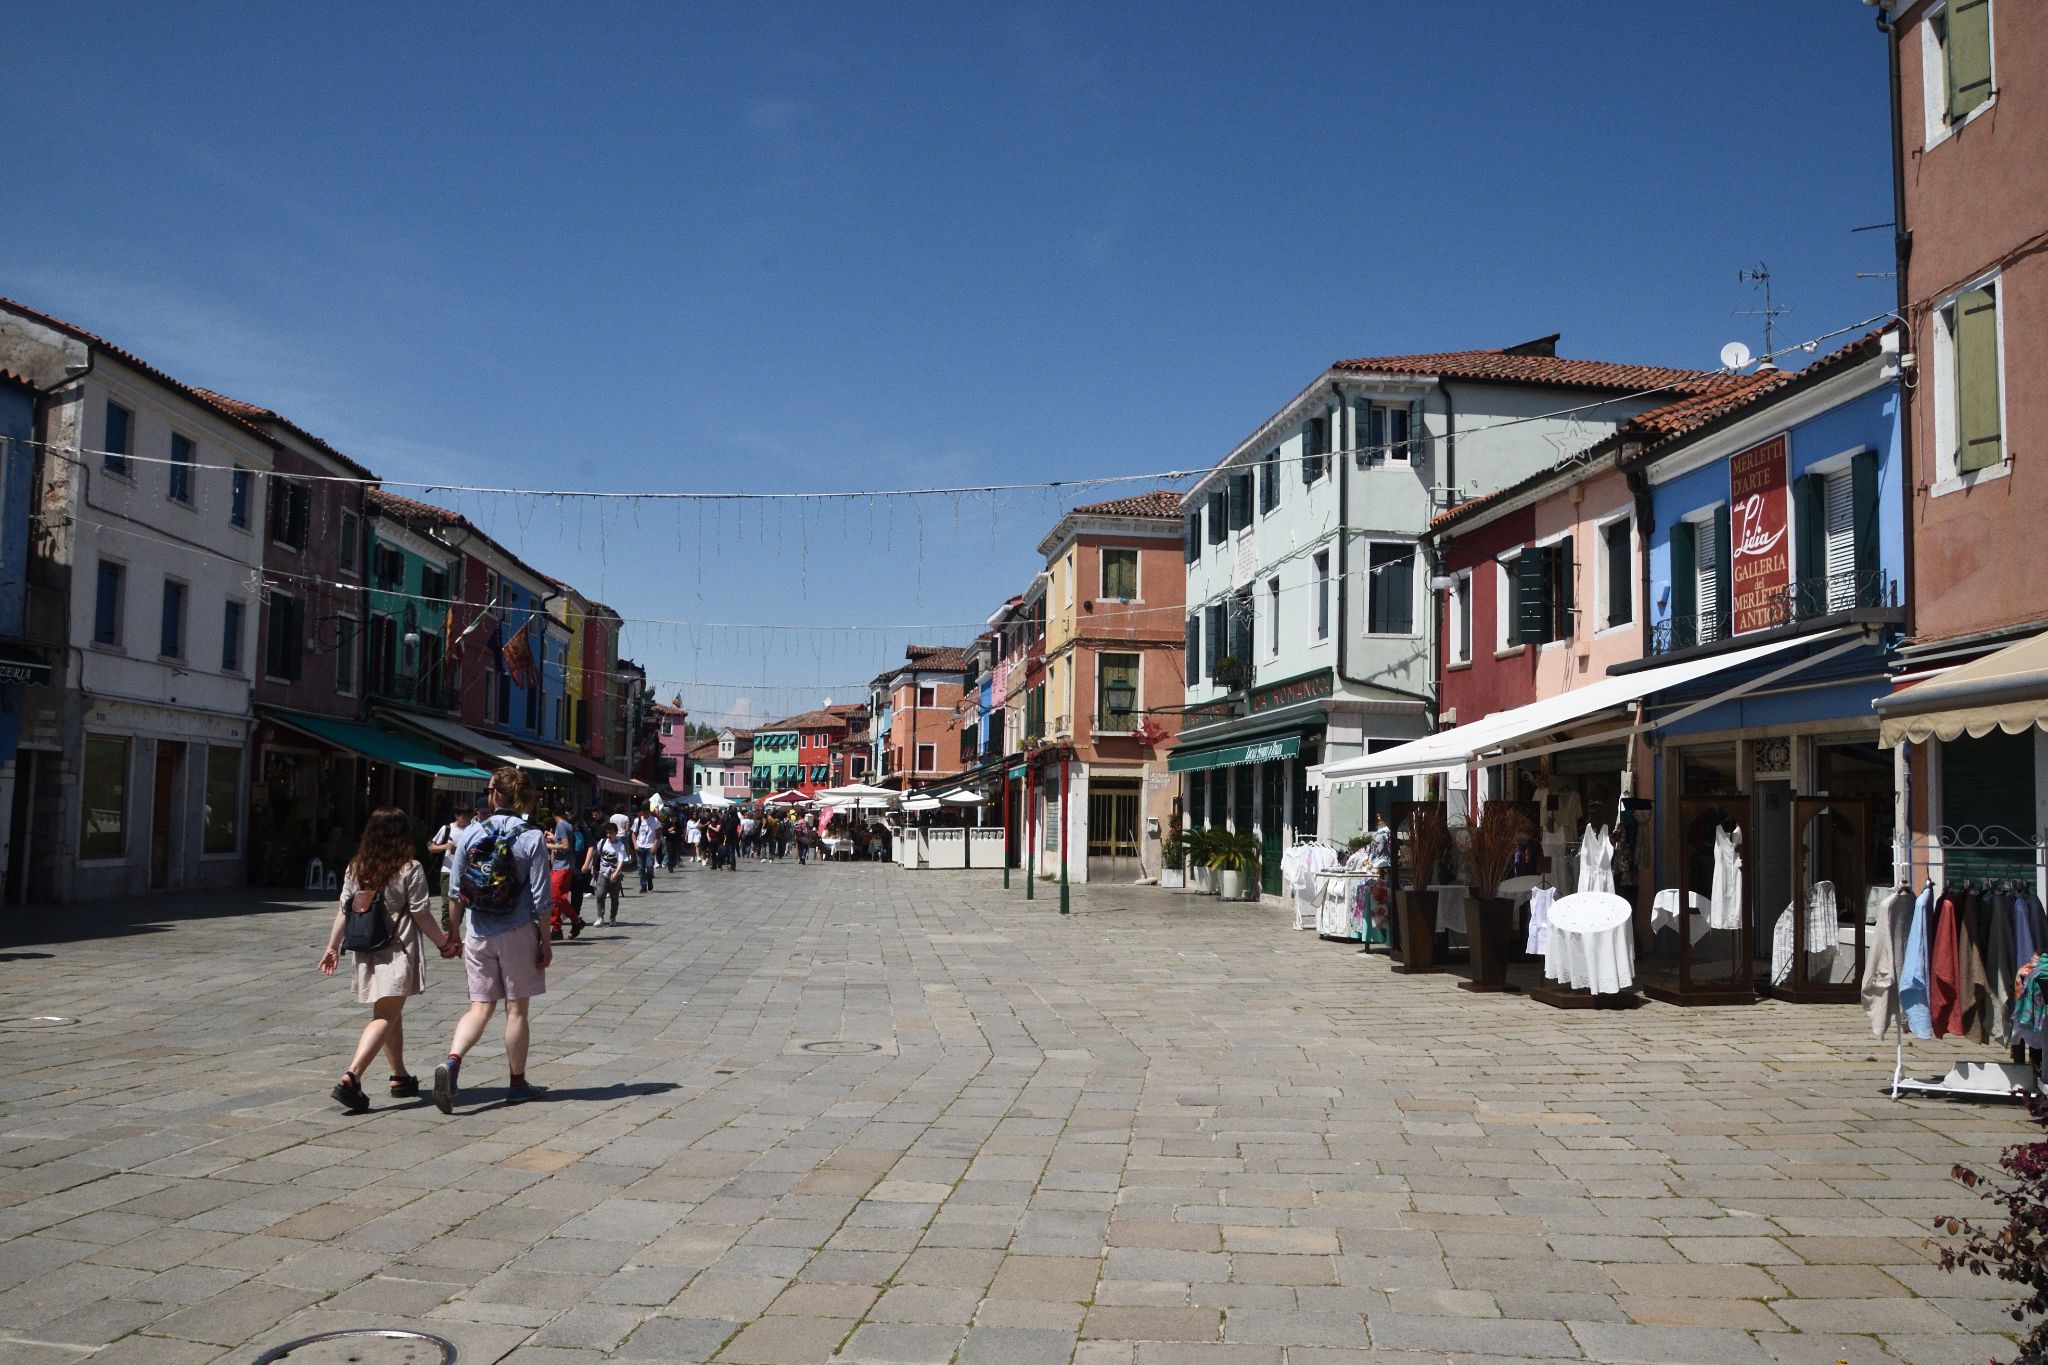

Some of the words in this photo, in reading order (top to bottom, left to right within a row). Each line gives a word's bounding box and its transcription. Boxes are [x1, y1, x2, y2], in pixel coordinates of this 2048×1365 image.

[1733, 440, 1783, 475] MERLETTI
[1734, 494, 1787, 558] Lidia
[1735, 554, 1787, 582] GALLERIA
[1754, 577, 1765, 590] del
[1740, 603, 1784, 630] ANTICO
